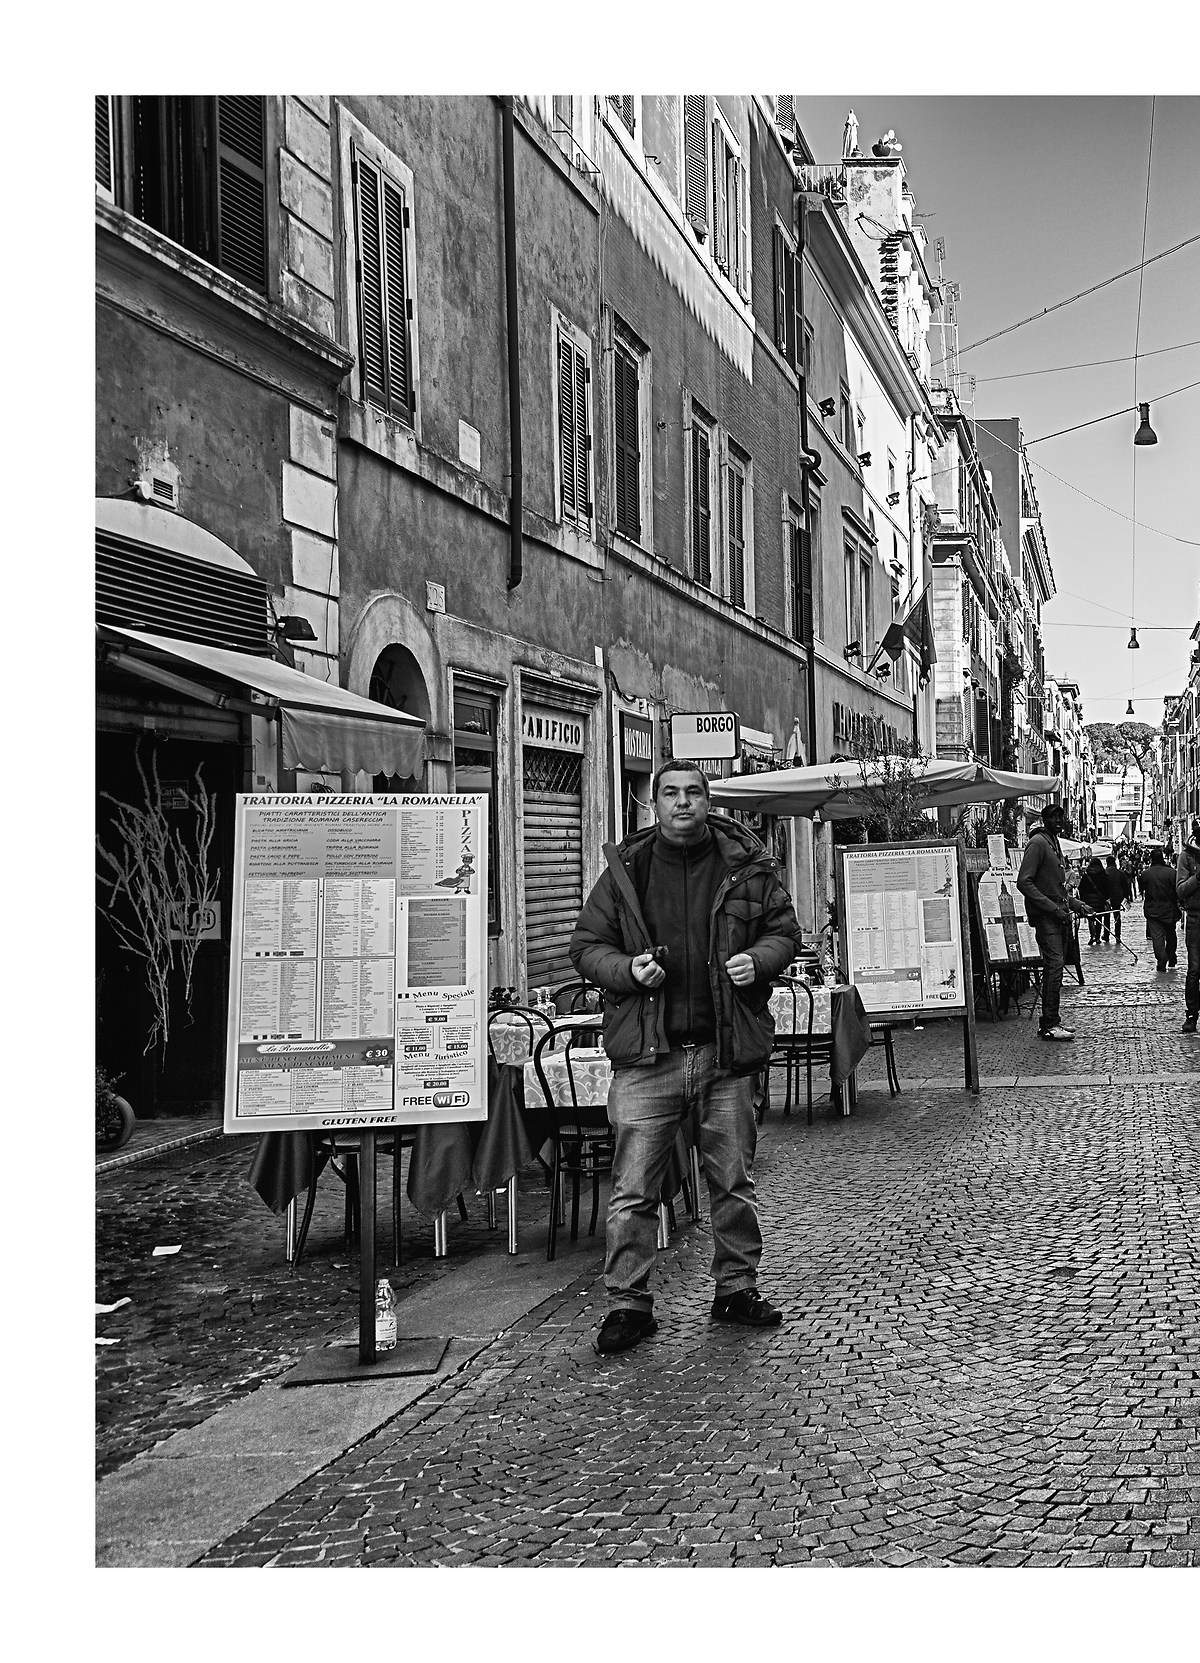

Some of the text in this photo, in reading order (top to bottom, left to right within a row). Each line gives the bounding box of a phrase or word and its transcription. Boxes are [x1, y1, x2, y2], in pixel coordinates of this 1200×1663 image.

[696, 716, 734, 733] BORGO
[521, 714, 581, 746] PANIFICIO
[243, 796, 313, 806] TRATTORIA
[316, 796, 375, 805] PIZZERIA
[460, 809, 472, 853] PIZZA
[412, 989, 475, 1001] Menu Speciale
[280, 1043, 331, 1052] Romanella
[365, 1049, 388, 1058] € 30
[404, 1050, 468, 1060] Menu Turistico
[403, 1096, 432, 1106] FREE
[322, 1117, 367, 1126] GLUTEN
